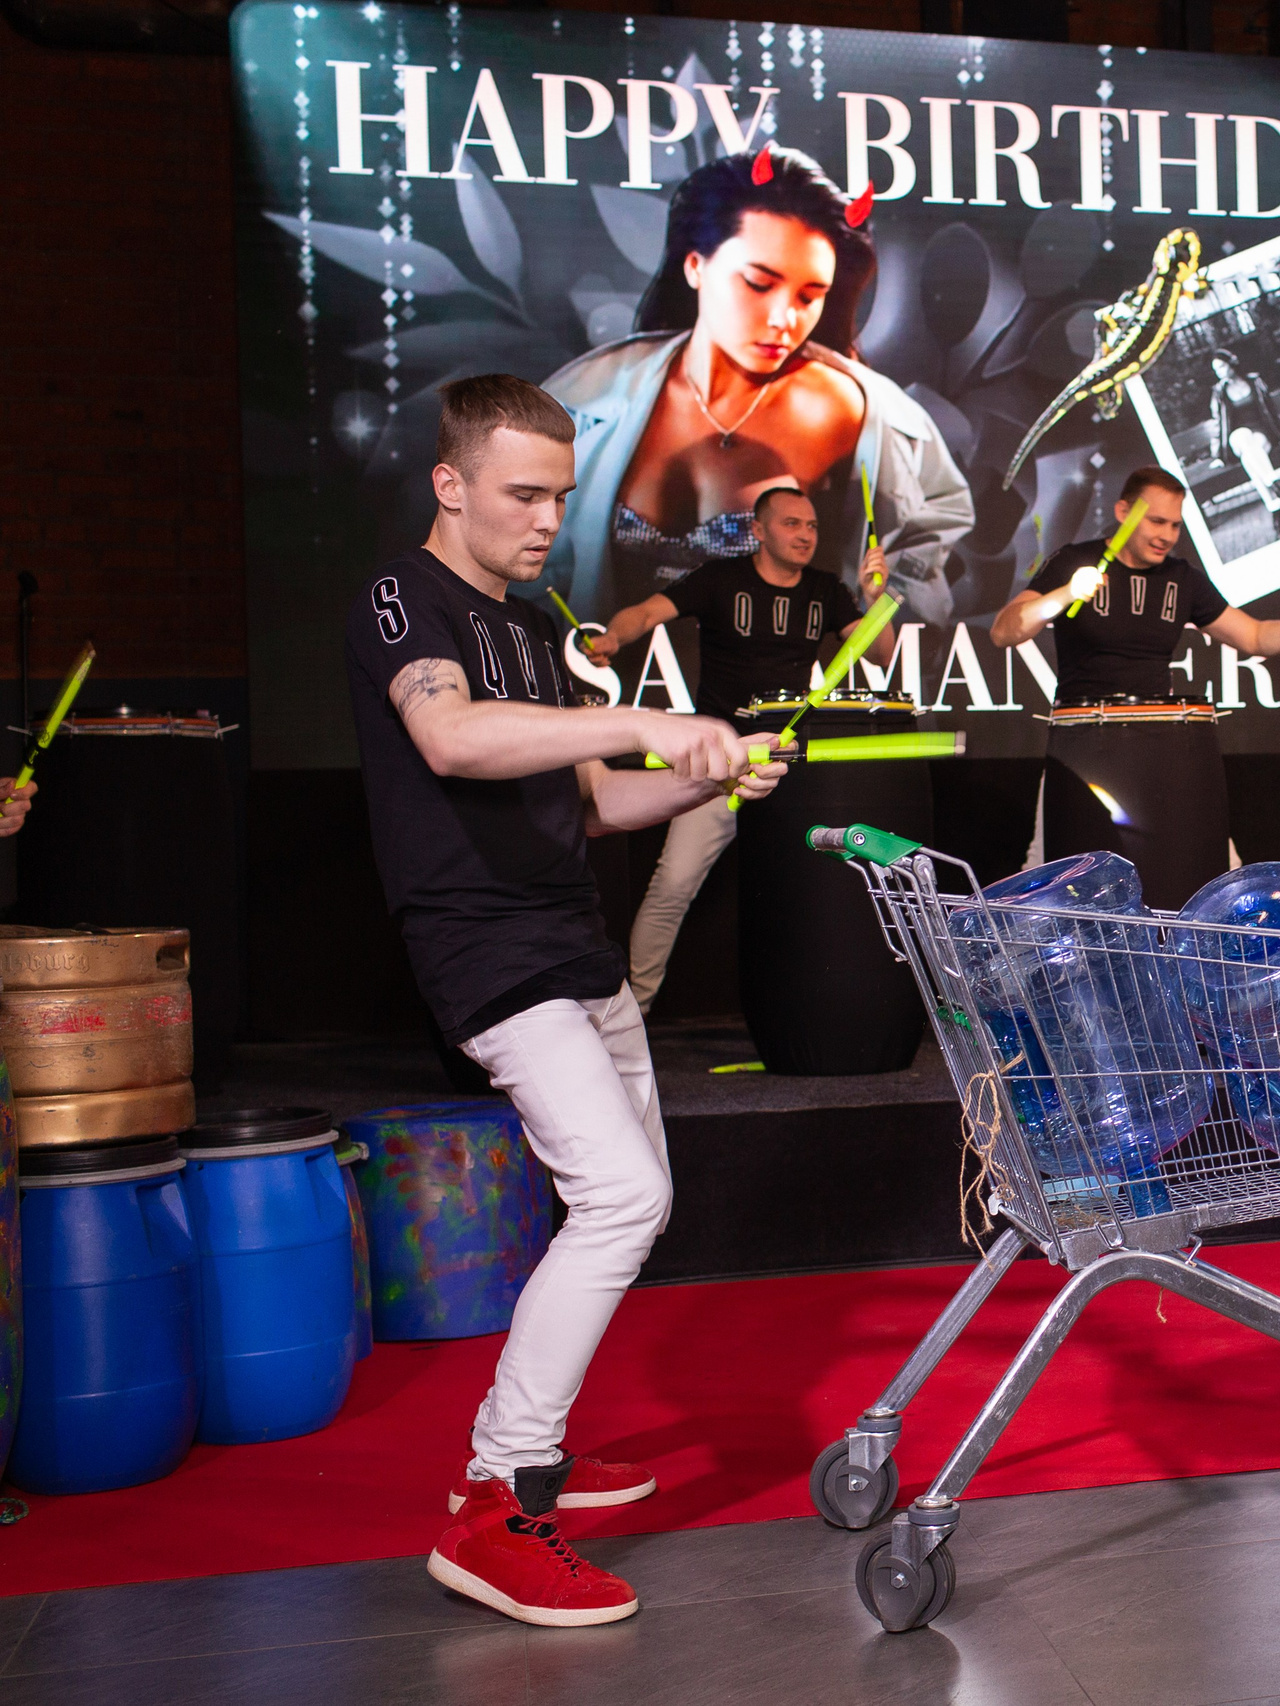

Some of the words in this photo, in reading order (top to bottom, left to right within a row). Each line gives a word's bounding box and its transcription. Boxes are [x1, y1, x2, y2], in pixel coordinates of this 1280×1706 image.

[325, 60, 780, 190] HAPPY
[372, 577, 409, 644] S
[734, 591, 823, 641] QVA
